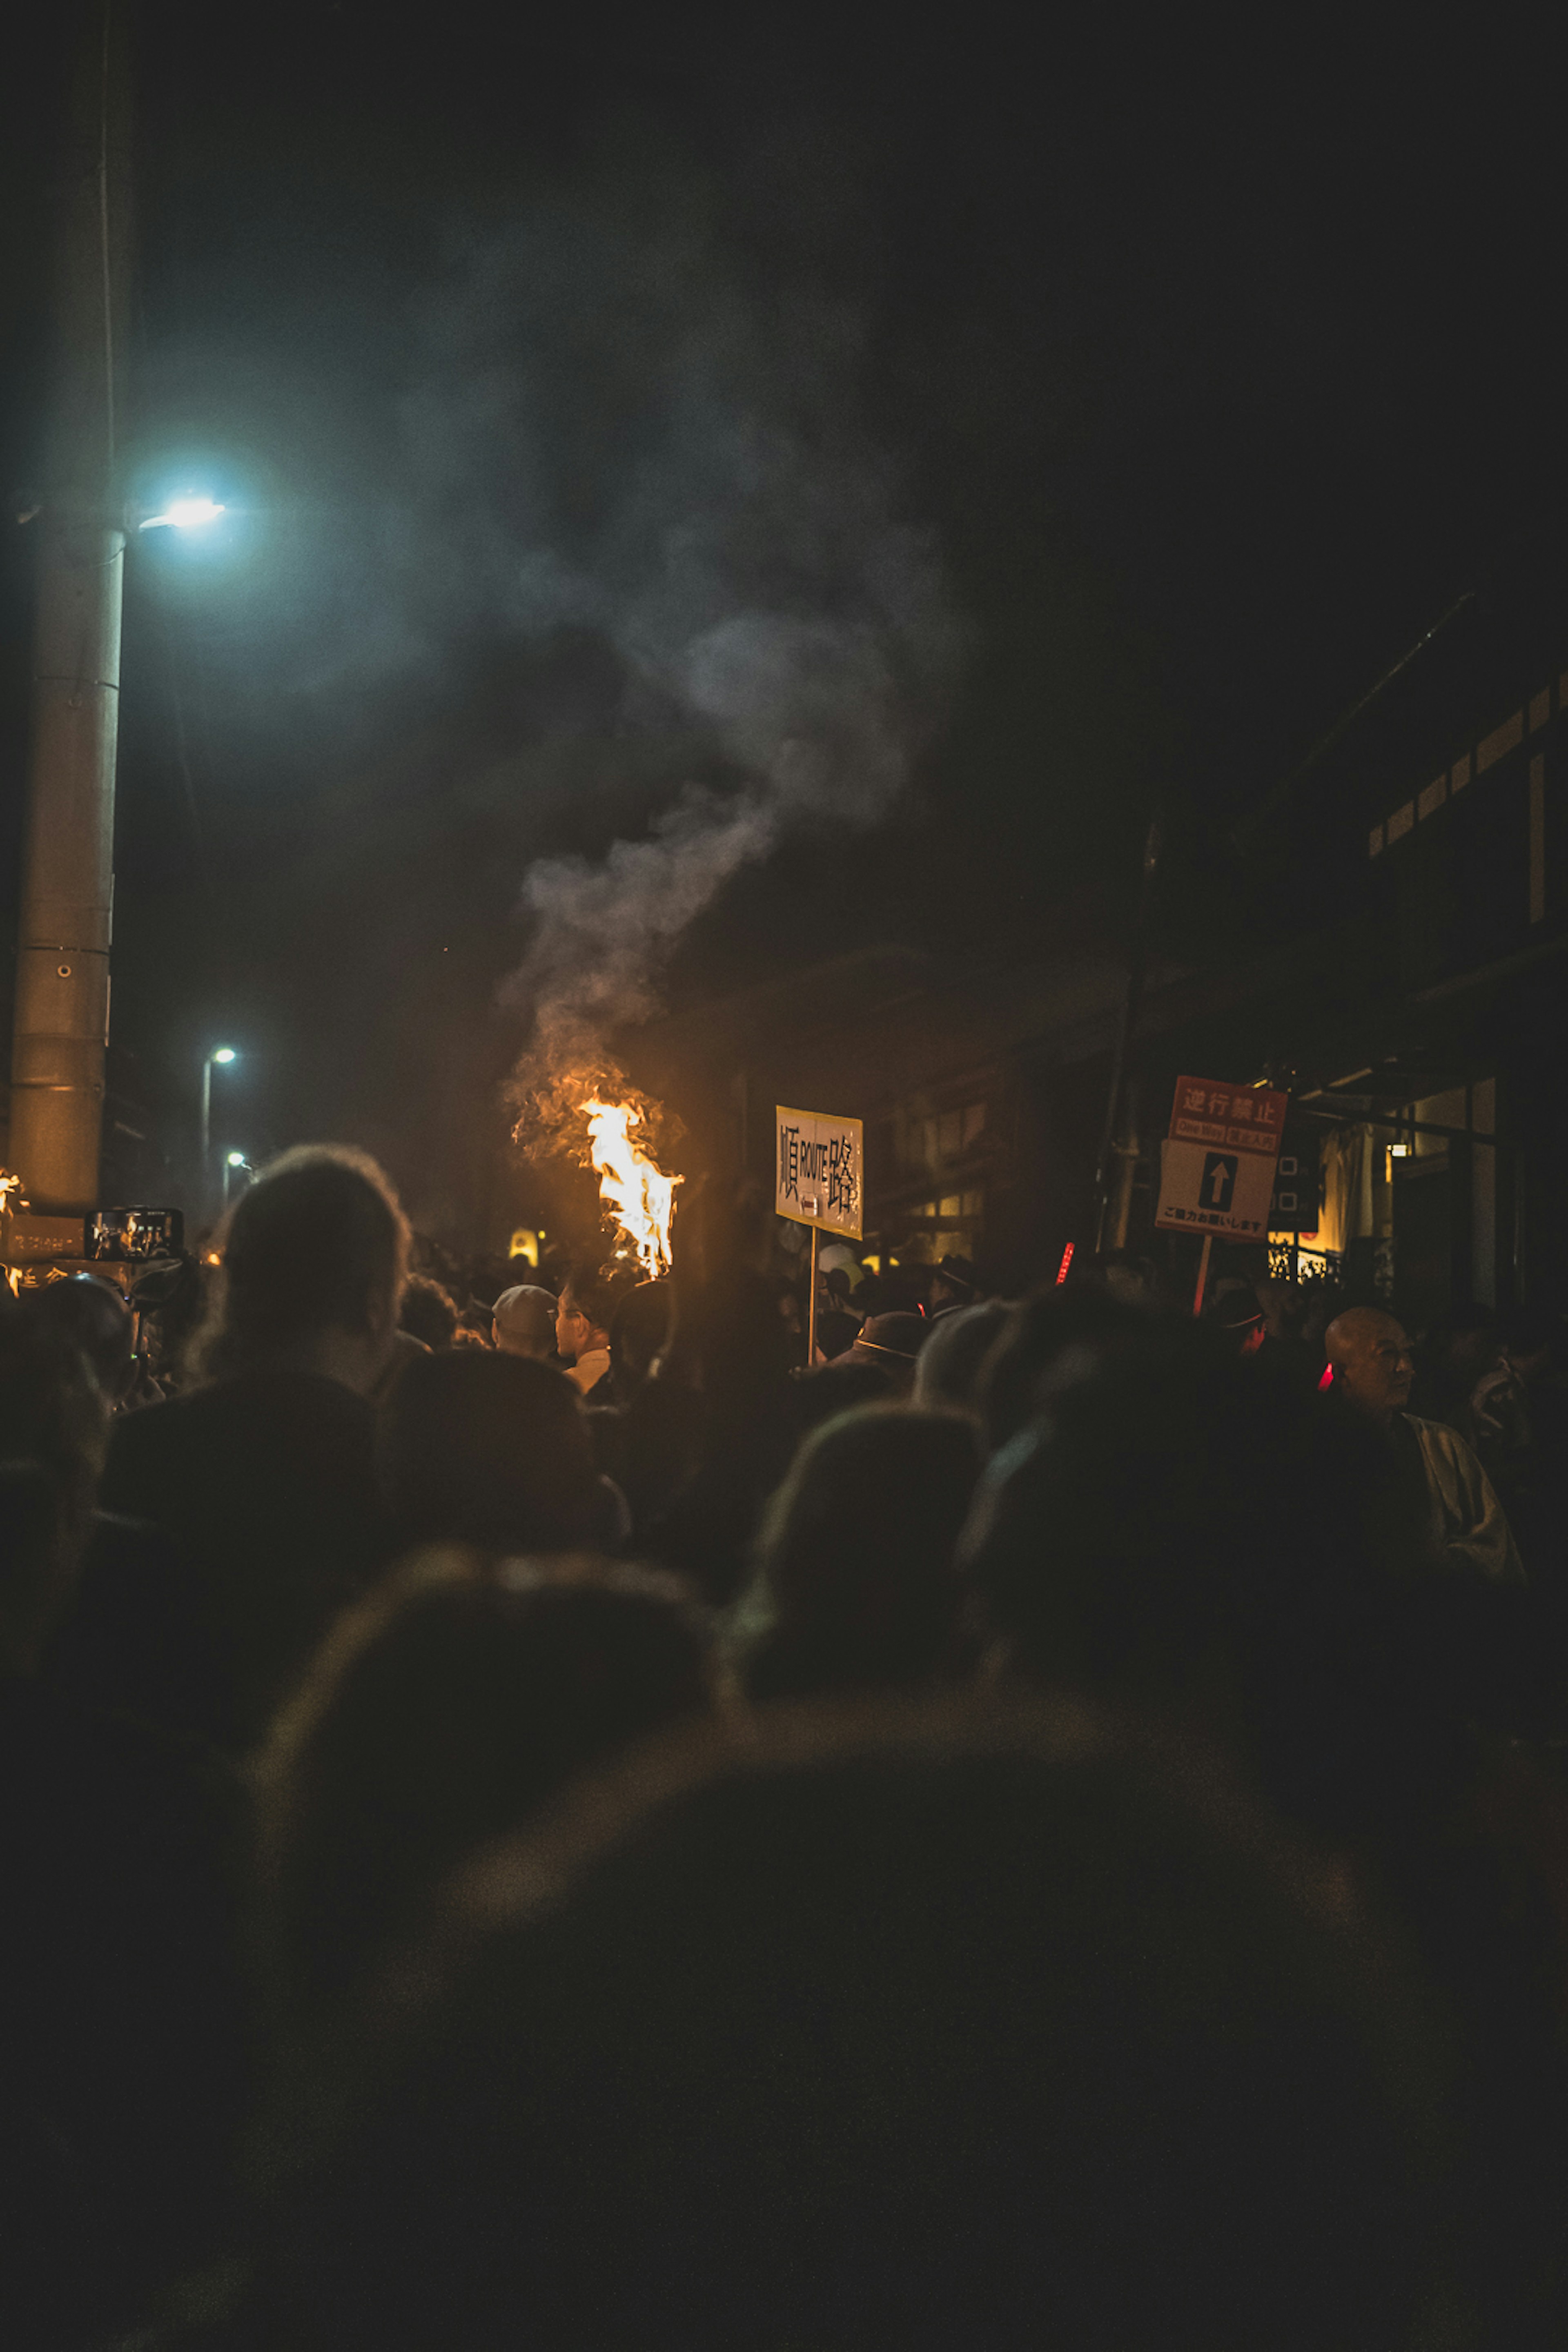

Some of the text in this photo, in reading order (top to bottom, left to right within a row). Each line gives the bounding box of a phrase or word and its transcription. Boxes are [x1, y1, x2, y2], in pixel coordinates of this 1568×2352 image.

[1183, 1087, 1276, 1125] 逆行禁止
[1179, 1122, 1221, 1141] One Way
[800, 1140, 828, 1181] ROUTE
